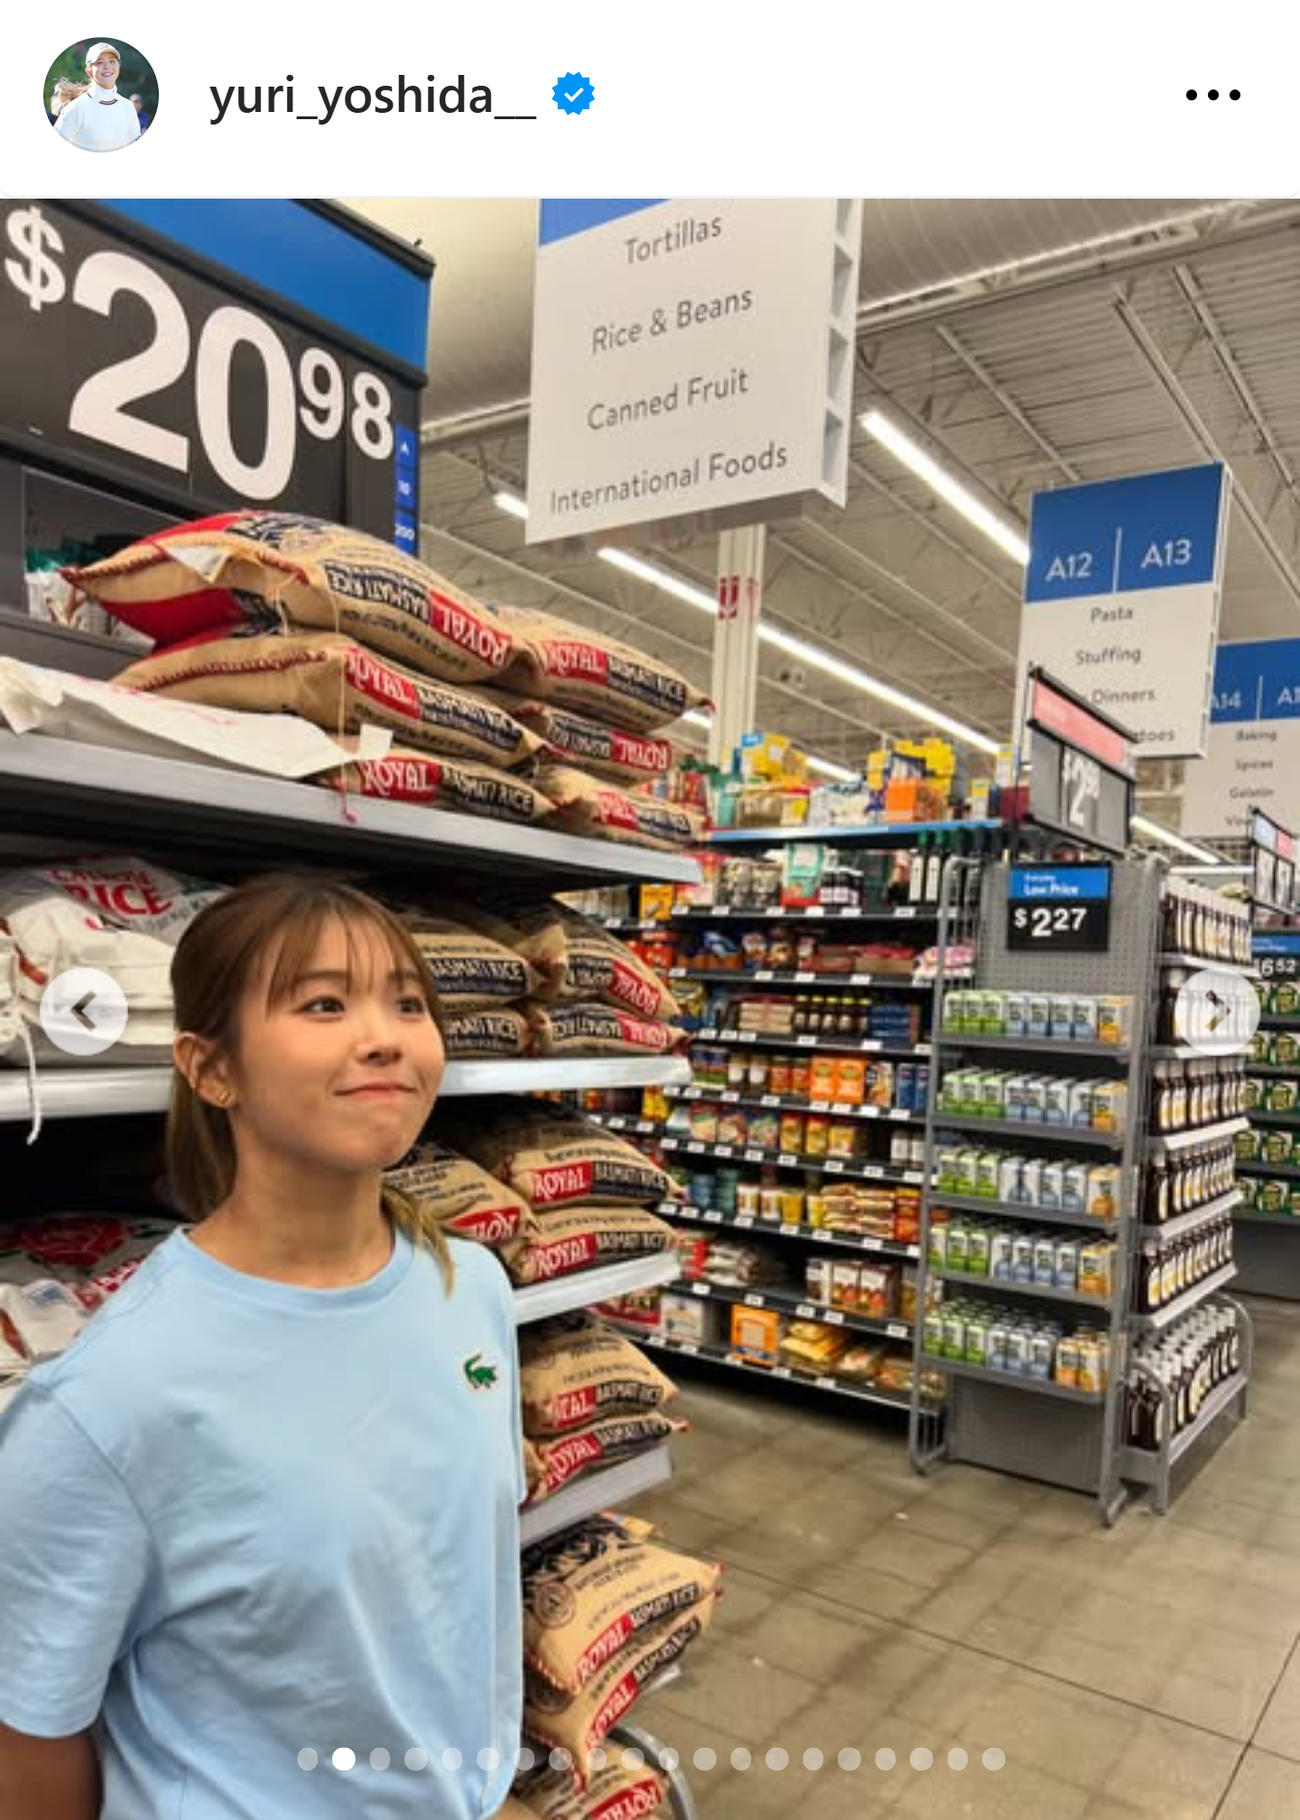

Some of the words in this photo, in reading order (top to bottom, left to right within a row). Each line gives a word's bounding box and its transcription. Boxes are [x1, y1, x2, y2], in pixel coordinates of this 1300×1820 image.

[625, 215, 723, 265] Tortillas
[592, 325, 642, 356] Rice
[649, 307, 668, 335] &
[676, 289, 753, 329] Beans
[587, 384, 678, 430] Canned
[687, 368, 749, 405] Fruit
[550, 457, 700, 514] International
[709, 442, 787, 481] Foods
[1045, 553, 1092, 582] A12
[1140, 540, 1193, 569] A13
[1090, 606, 1133, 624] Pasta
[440, 605, 509, 668] ROYAL
[545, 643, 605, 677] ROYAL
[1075, 646, 1141, 666] Stuffing
[1091, 688, 1155, 704] Dinners
[360, 761, 437, 797] ROYAL
[1050, 881, 1079, 896] Price
[1014, 907, 1088, 937] $227
[533, 1165, 589, 1201] ROYAL
[536, 1236, 590, 1278] ROYAL
[578, 1620, 630, 1684] ROYAL
